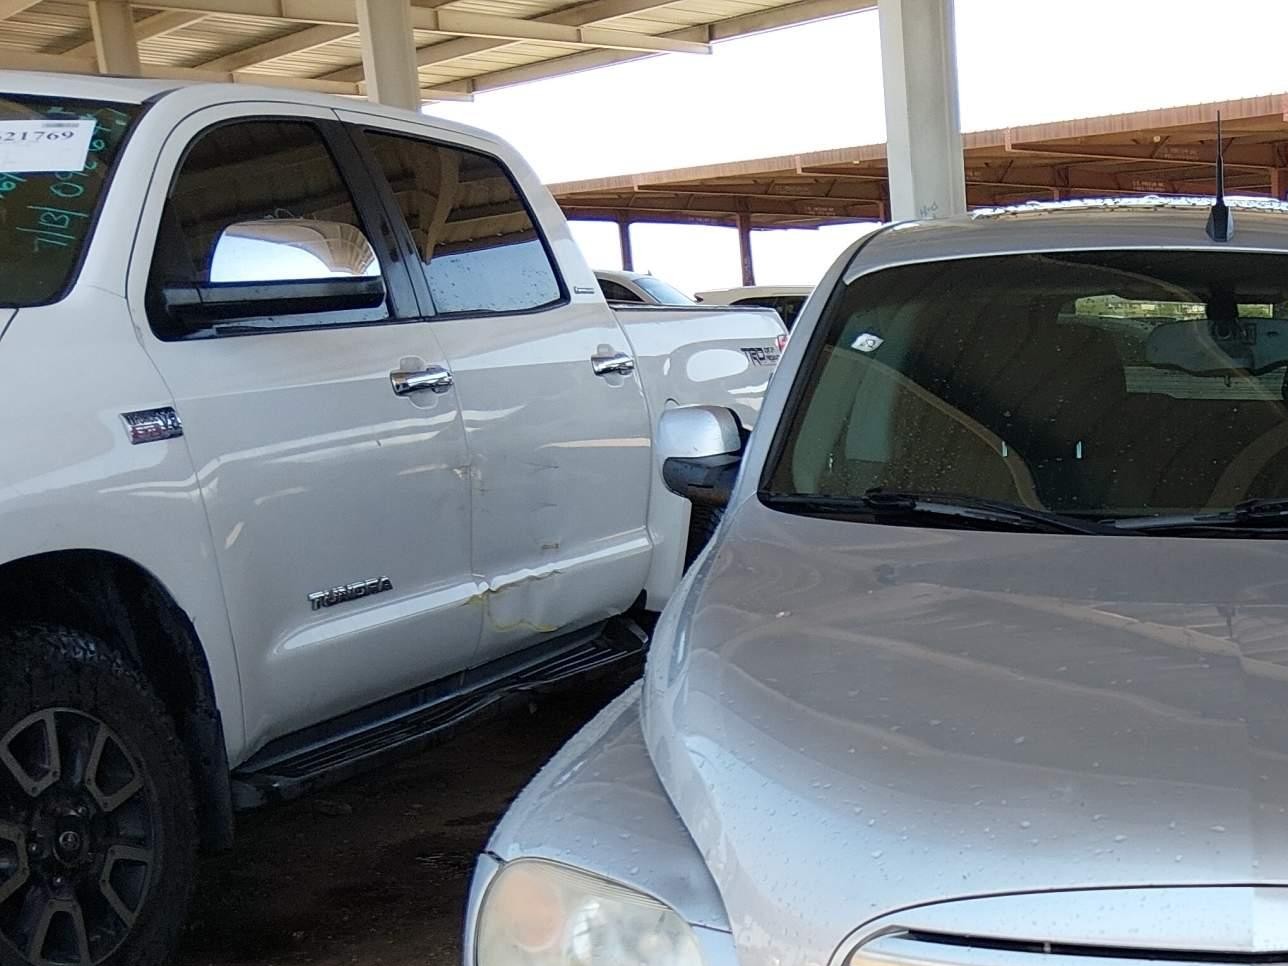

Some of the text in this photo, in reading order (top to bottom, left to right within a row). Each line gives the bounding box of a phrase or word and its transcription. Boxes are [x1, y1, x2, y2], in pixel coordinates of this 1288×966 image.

[0, 131, 74, 141] 21769
[741, 347, 766, 367] TRD
[307, 576, 393, 611] TUNDRA
